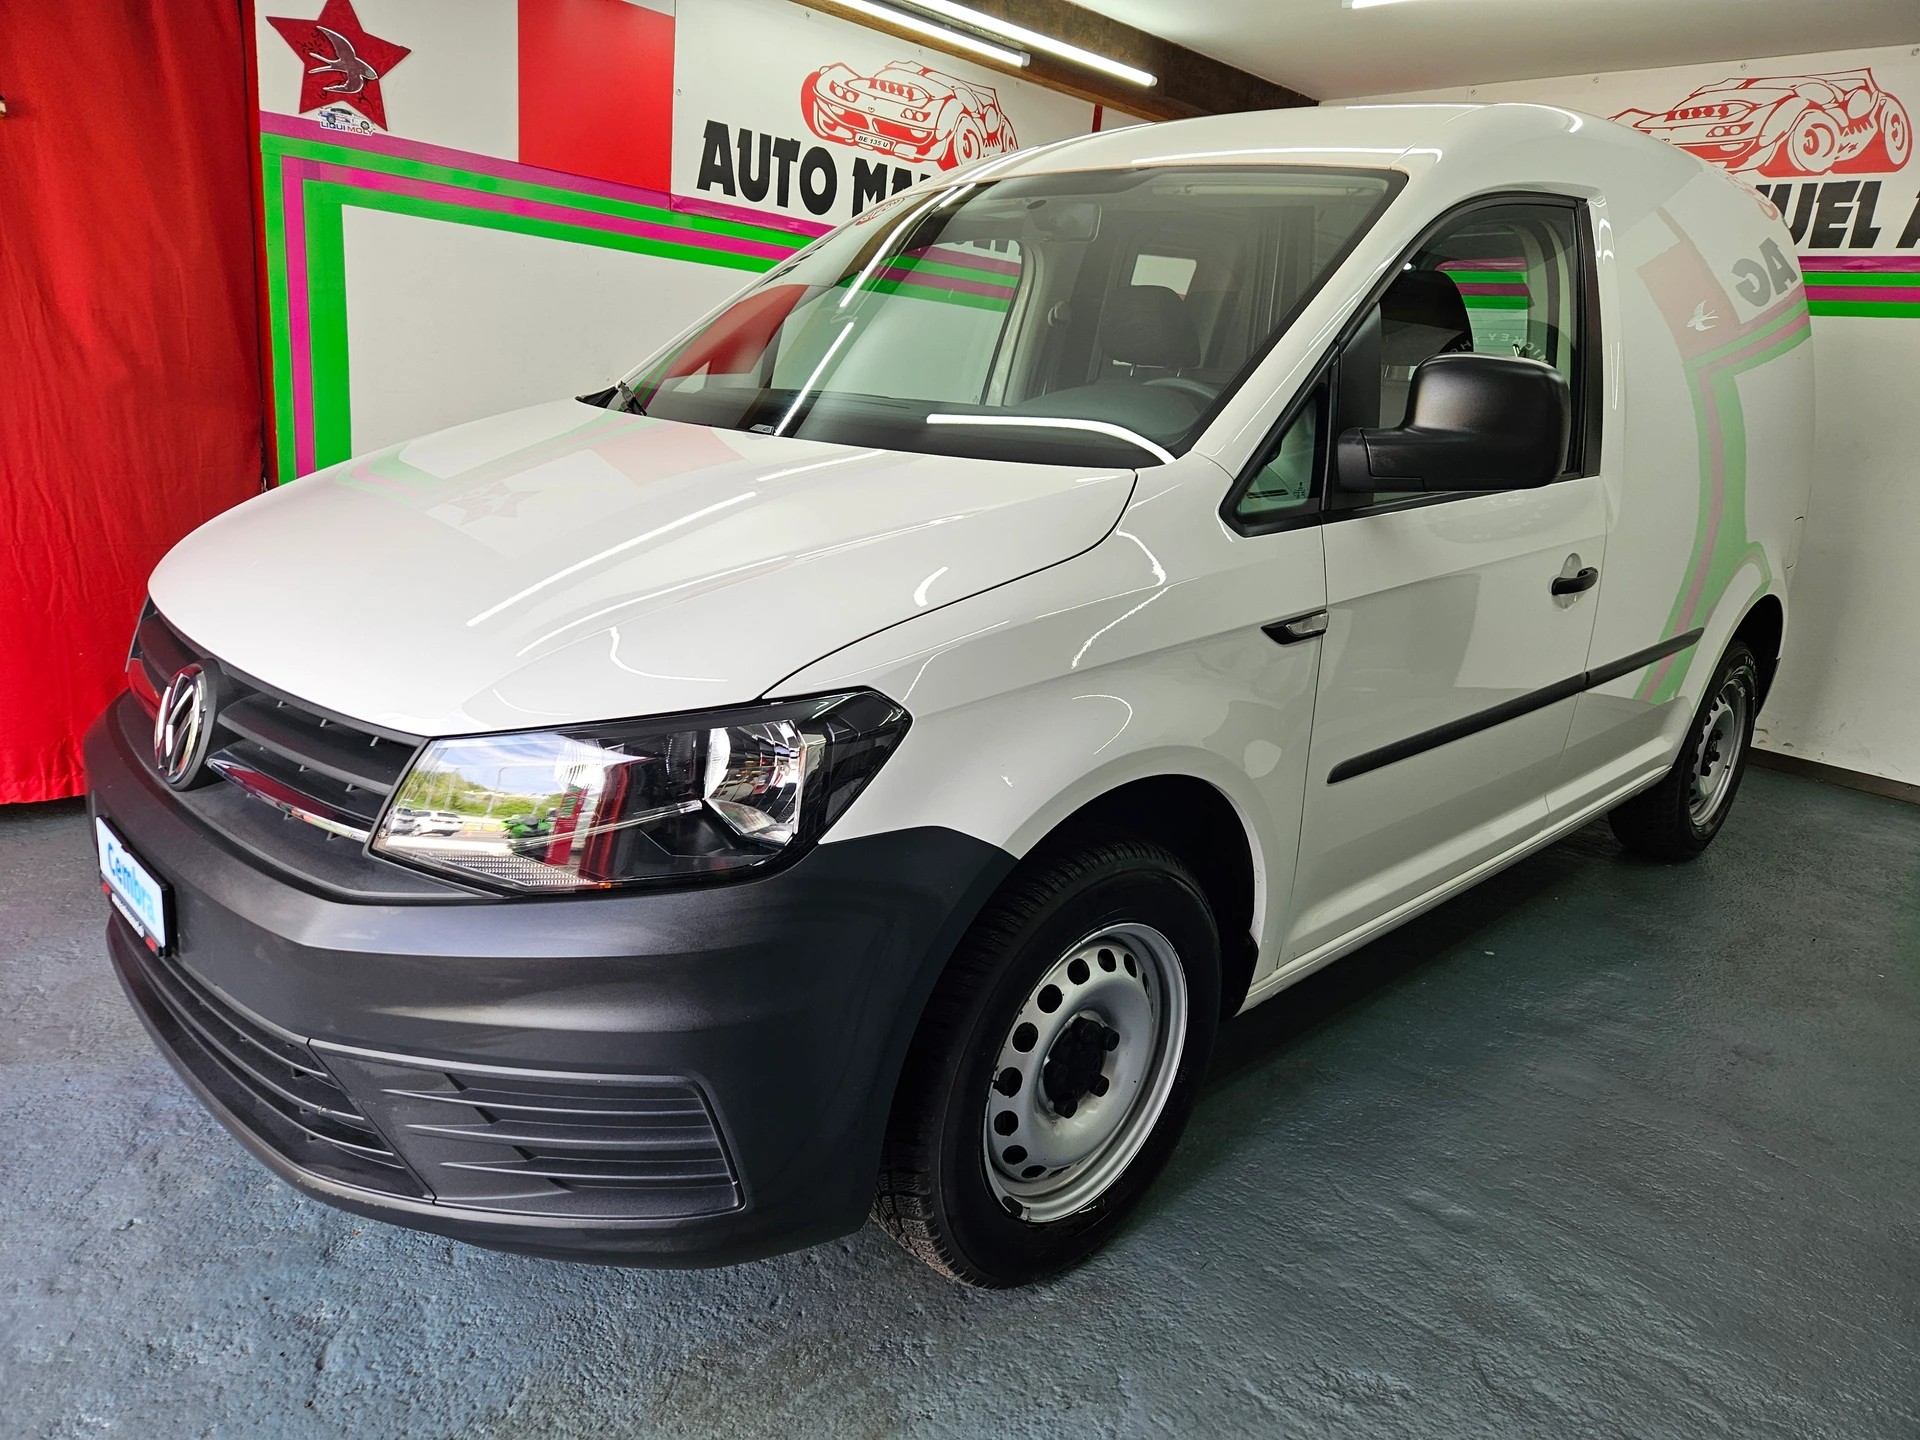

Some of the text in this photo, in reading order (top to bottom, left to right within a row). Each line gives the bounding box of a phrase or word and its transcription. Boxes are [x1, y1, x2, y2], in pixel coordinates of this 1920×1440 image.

[321, 121, 373, 135] LIQUI MOLY
[870, 138, 882, 146] 135
[697, 119, 838, 216] AUTO
[1755, 181, 1882, 249] UEL
